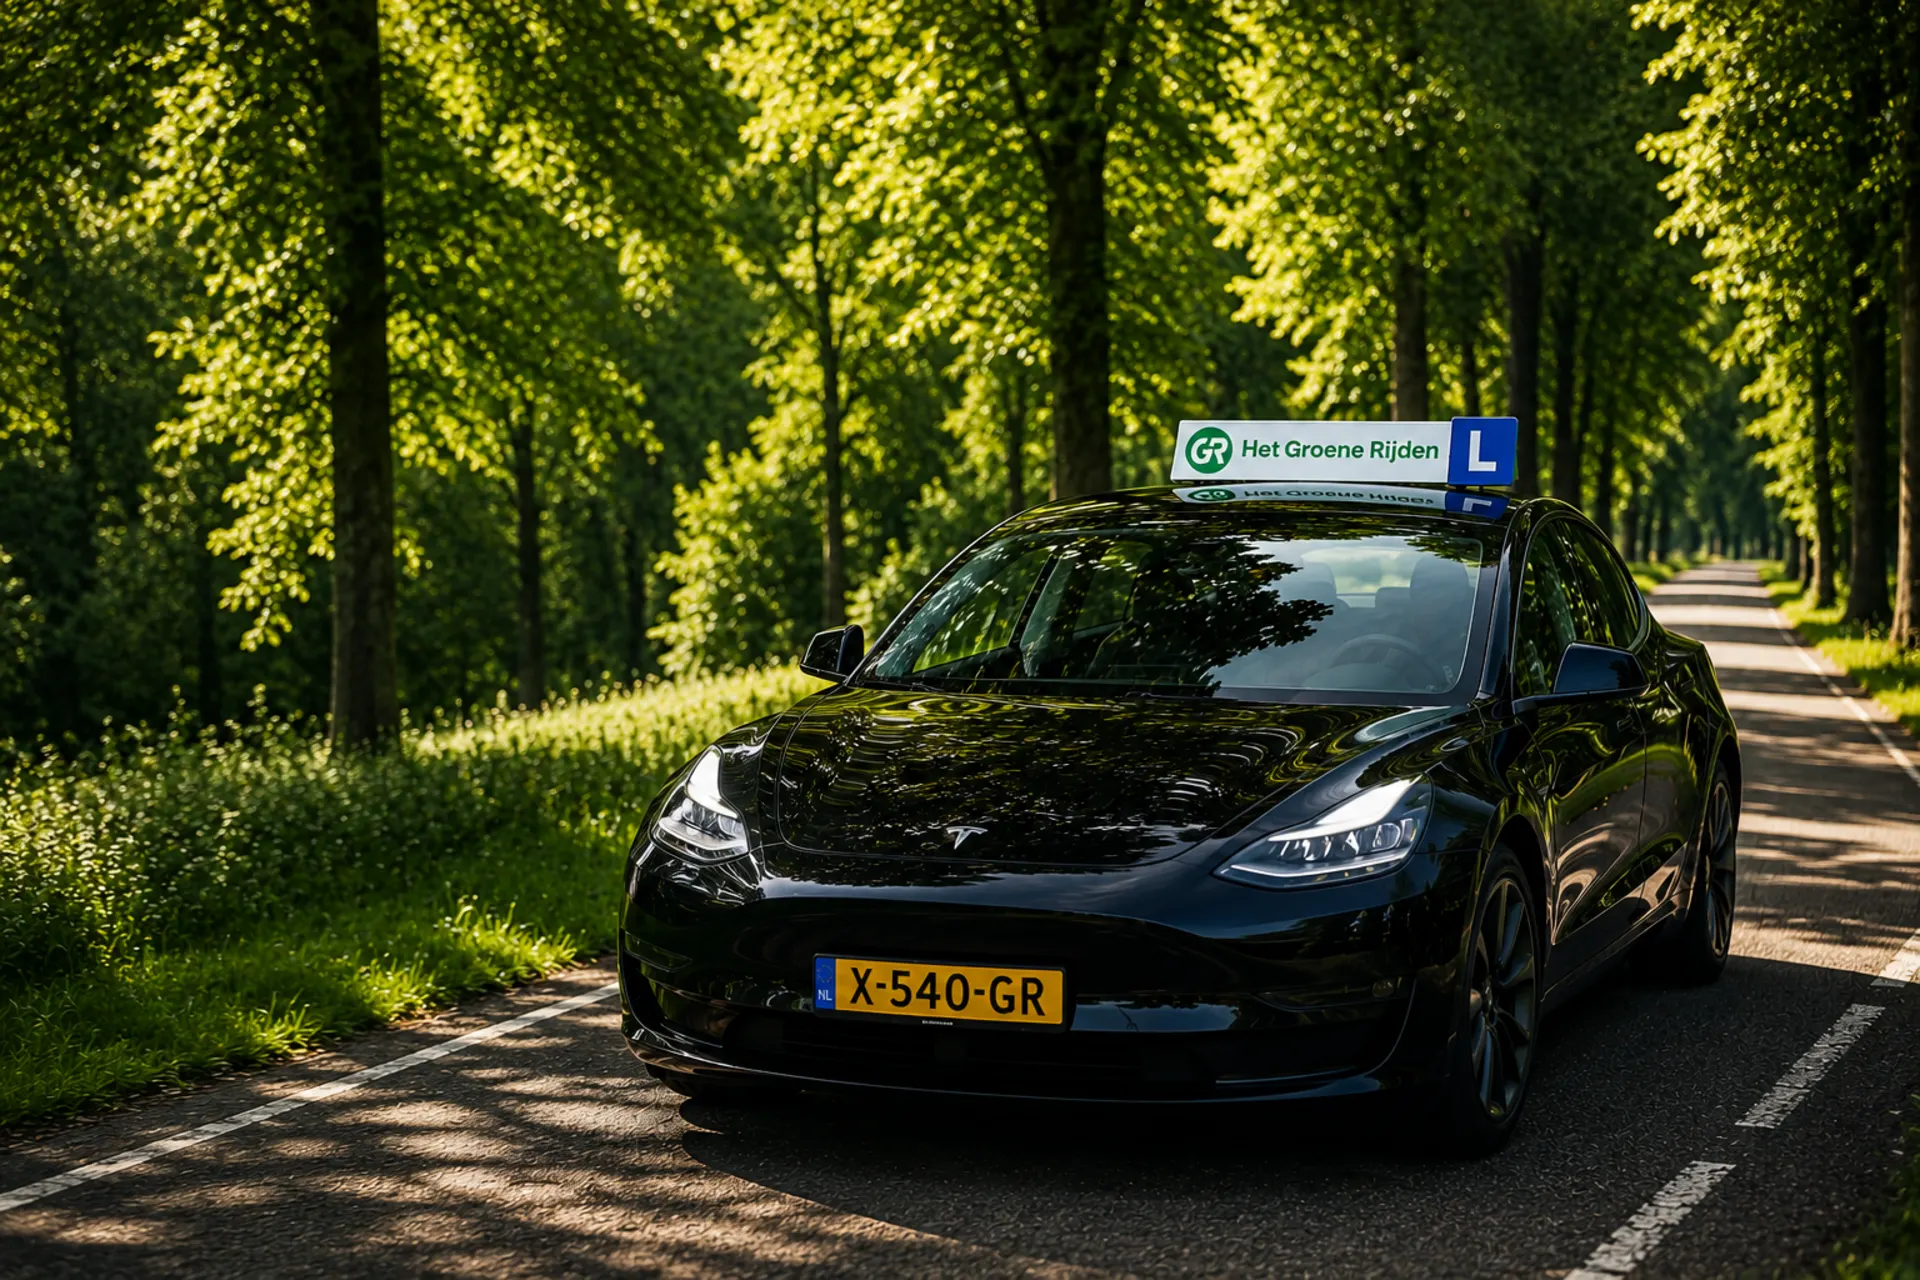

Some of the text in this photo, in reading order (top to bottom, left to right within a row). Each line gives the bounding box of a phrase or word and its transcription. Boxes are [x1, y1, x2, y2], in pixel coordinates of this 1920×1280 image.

[1190, 436, 1229, 466] GR
[1242, 439, 1439, 463] Het Groene Rijden
[1468, 430, 1497, 472] L
[818, 989, 833, 1001] NL
[849, 967, 1046, 1016] X-540-GR
